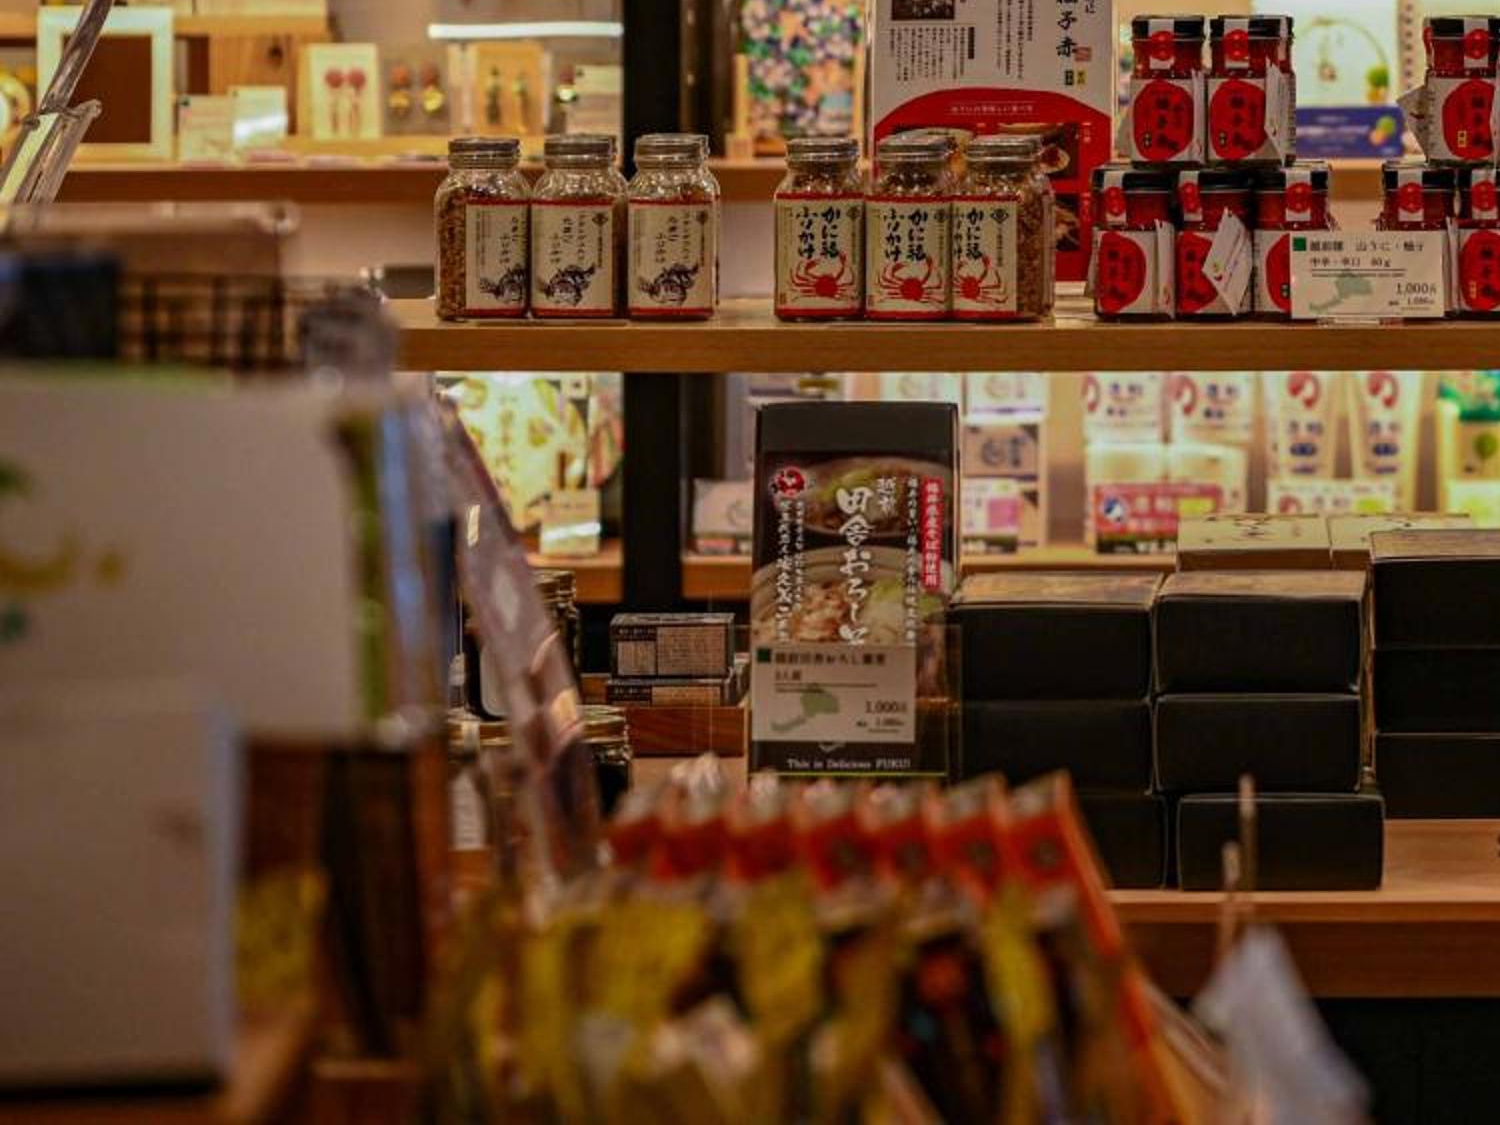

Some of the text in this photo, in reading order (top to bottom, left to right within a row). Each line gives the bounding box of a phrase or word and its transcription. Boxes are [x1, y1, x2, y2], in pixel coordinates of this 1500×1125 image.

[795, 206, 816, 261] ふりかけ
[883, 208, 904, 262] ふりかけ
[787, 758, 809, 769] This
[826, 758, 871, 769] Delicious
